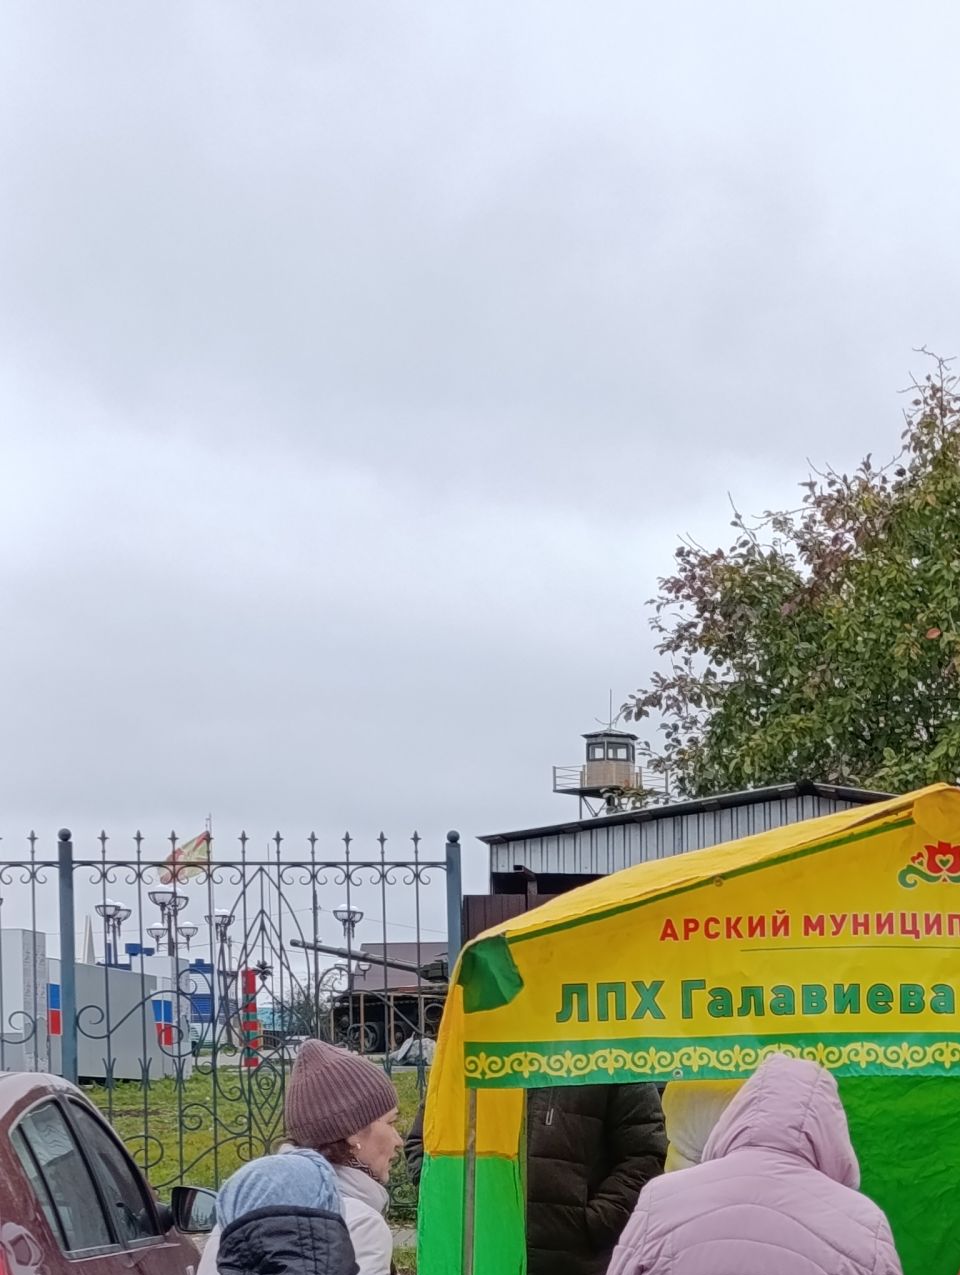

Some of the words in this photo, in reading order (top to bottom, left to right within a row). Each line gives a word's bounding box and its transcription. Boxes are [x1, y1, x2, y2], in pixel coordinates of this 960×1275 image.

[659, 909, 791, 942] АРСКИЙ
[555, 979, 666, 1023] ЛПХ
[681, 978, 956, 1020] Галавиева
